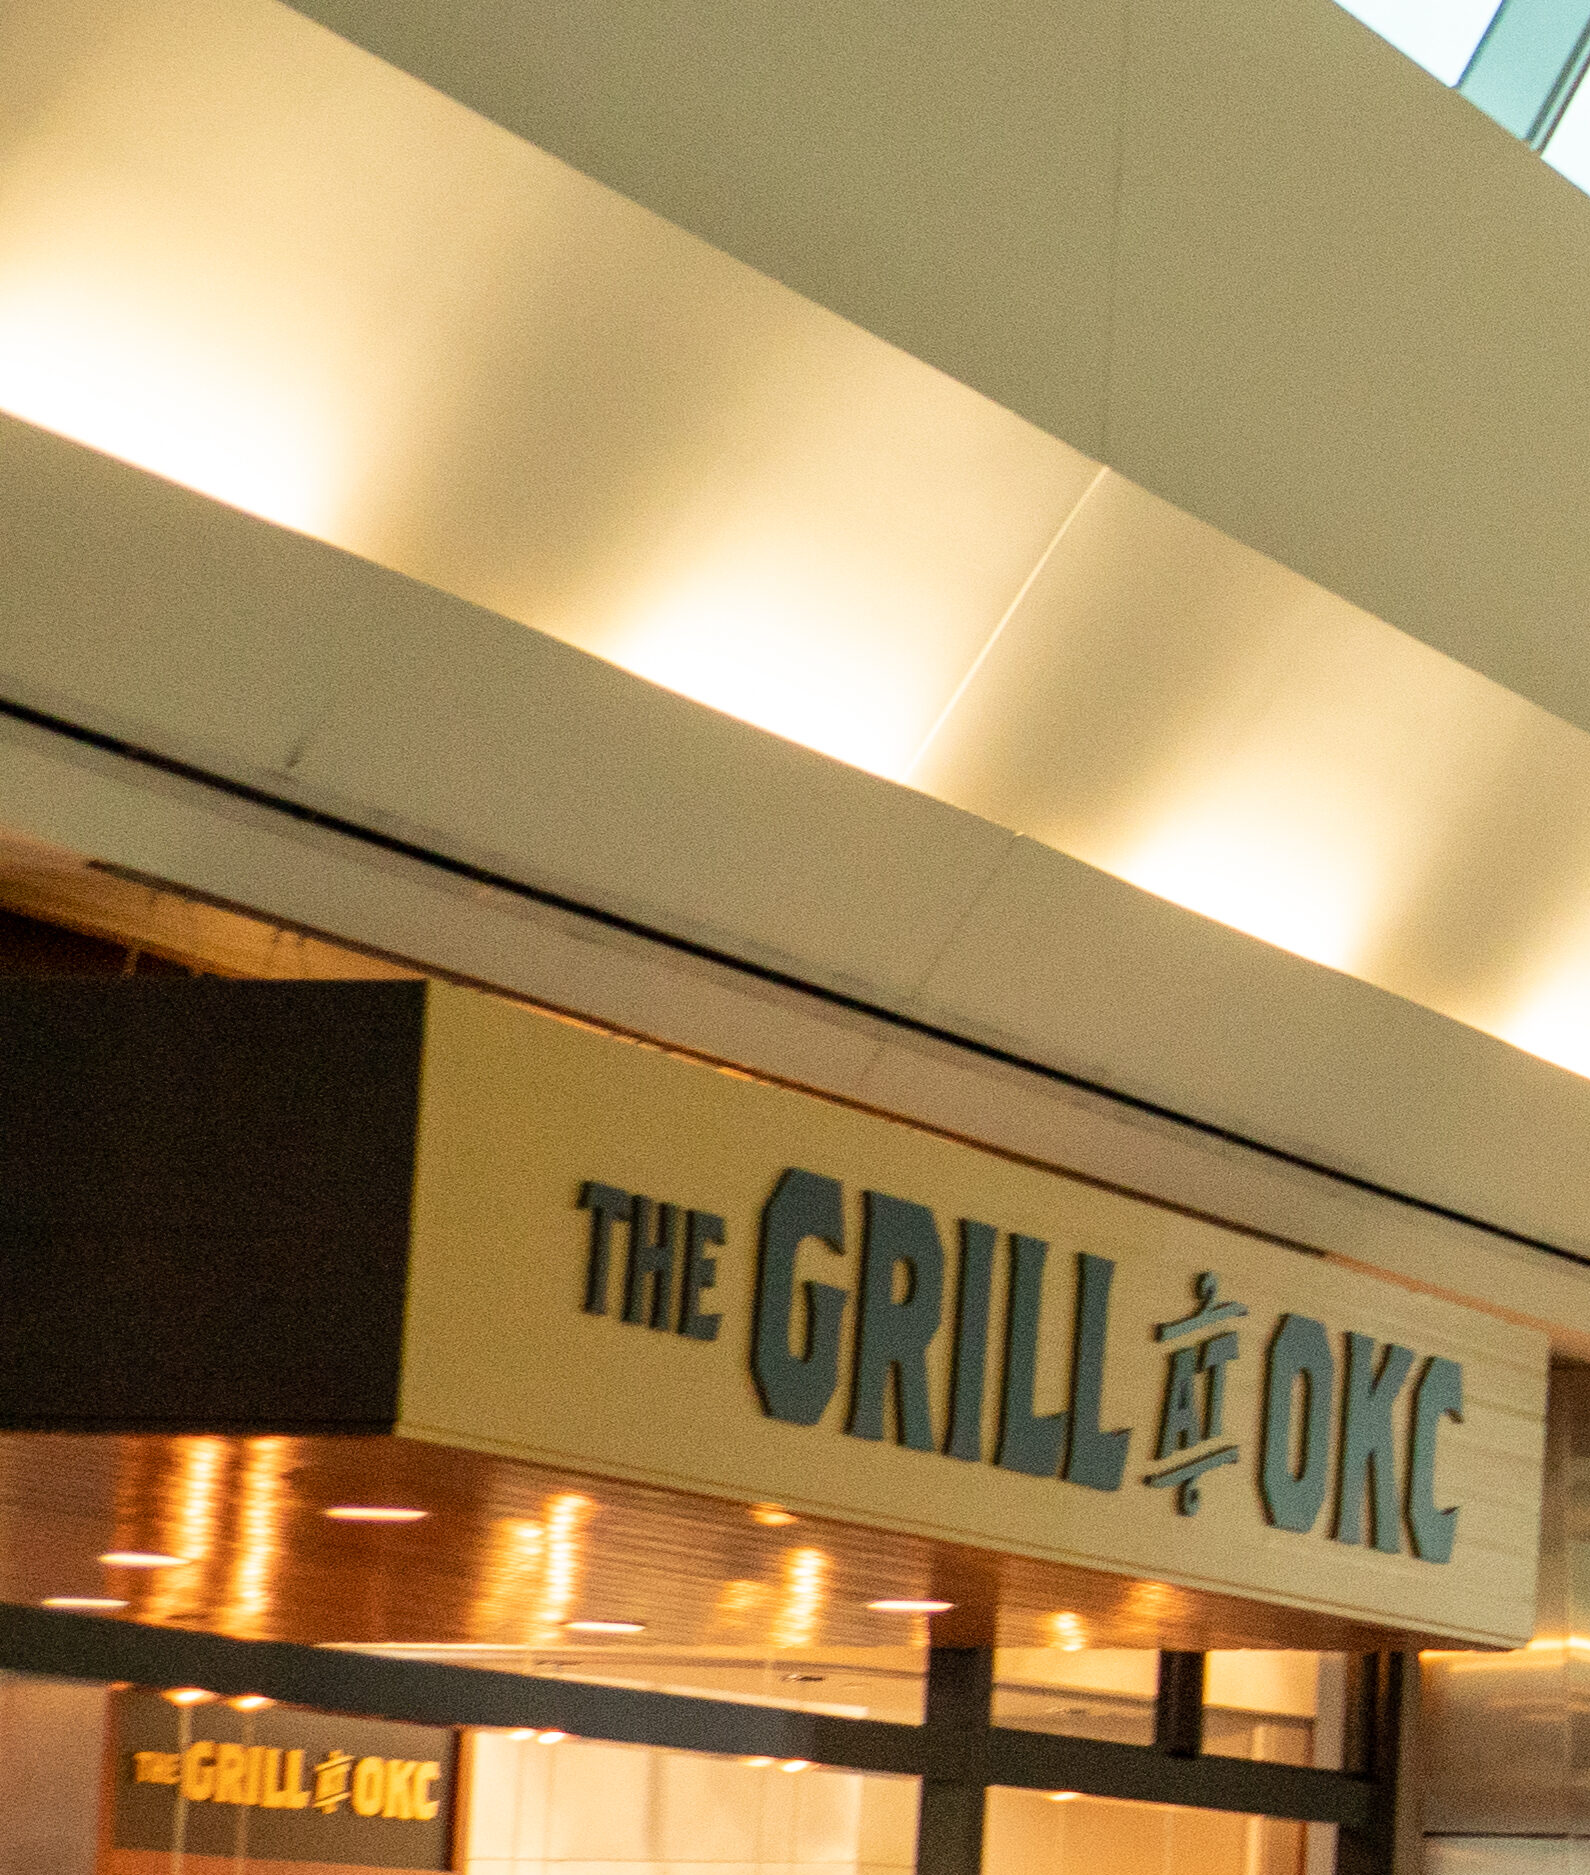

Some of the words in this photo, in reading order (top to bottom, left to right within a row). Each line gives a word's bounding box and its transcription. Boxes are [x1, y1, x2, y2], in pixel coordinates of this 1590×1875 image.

[576, 1179, 727, 1343] THE
[748, 1166, 1133, 1493] GRILL
[1155, 1329, 1241, 1461] AT
[1257, 1312, 1467, 1566] OKC
[181, 1740, 312, 1810] GRILL
[353, 1756, 440, 1821] OKC
